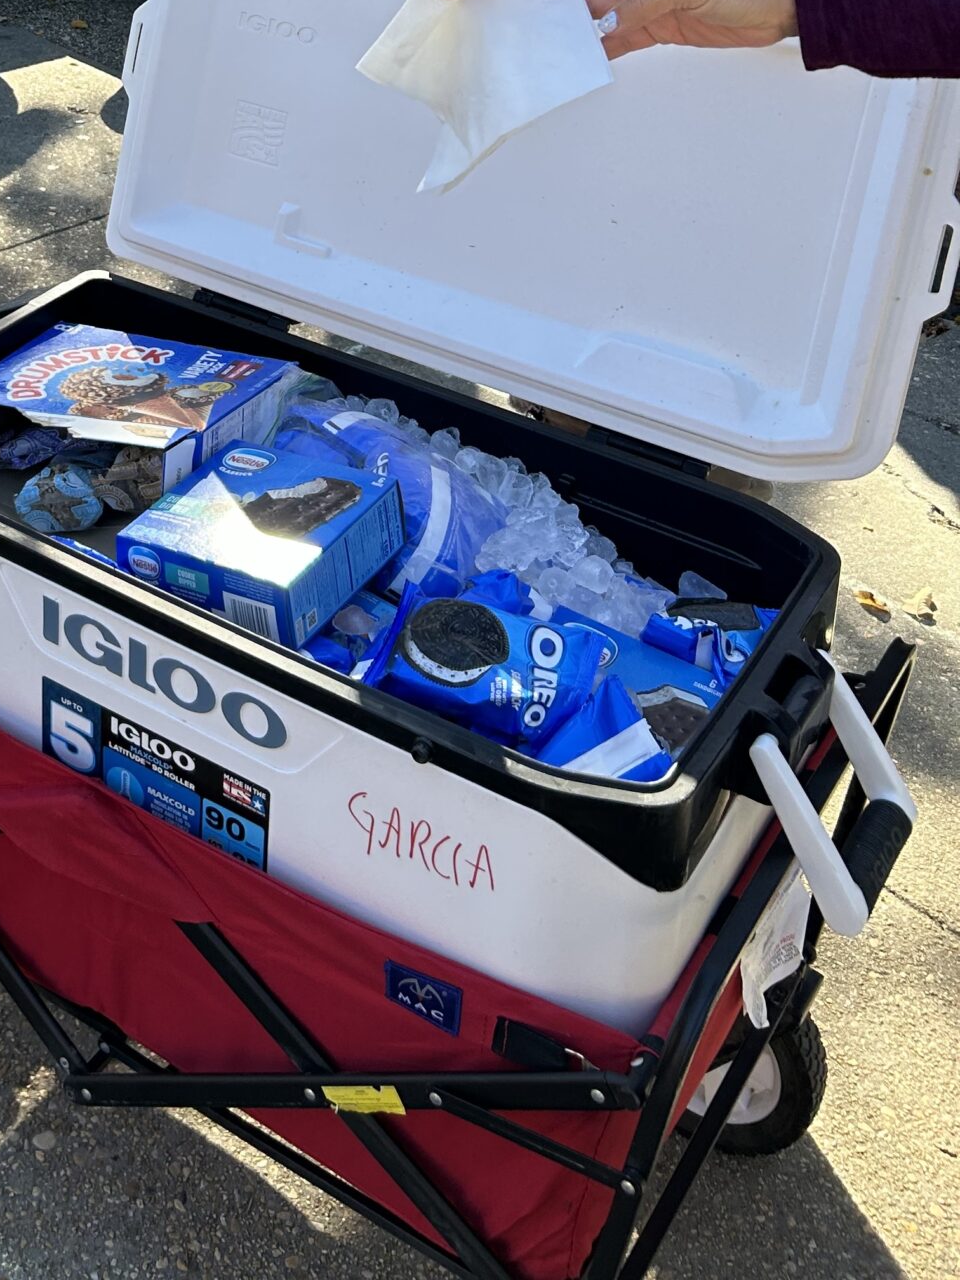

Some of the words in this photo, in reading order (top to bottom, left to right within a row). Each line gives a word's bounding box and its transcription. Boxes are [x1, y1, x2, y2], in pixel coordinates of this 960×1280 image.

[7, 343, 176, 402] DRUMSTICK
[178, 350, 224, 379] VARIETY
[43, 595, 288, 749] IGLOO
[523, 626, 564, 727] OREO
[61, 696, 72, 706] UP
[72, 701, 84, 713] TO
[50, 699, 96, 773] 5
[110, 716, 196, 772] IGLOO
[151, 764, 163, 775] 90
[163, 767, 196, 791] ROLLER
[223, 773, 245, 787] MADE
[244, 783, 252, 792] IN
[252, 788, 267, 800] THE
[147, 786, 196, 816] MAXCOLD
[204, 805, 246, 842] 90
[347, 791, 495, 891] GARCIA
[398, 991, 444, 1021] MAC
